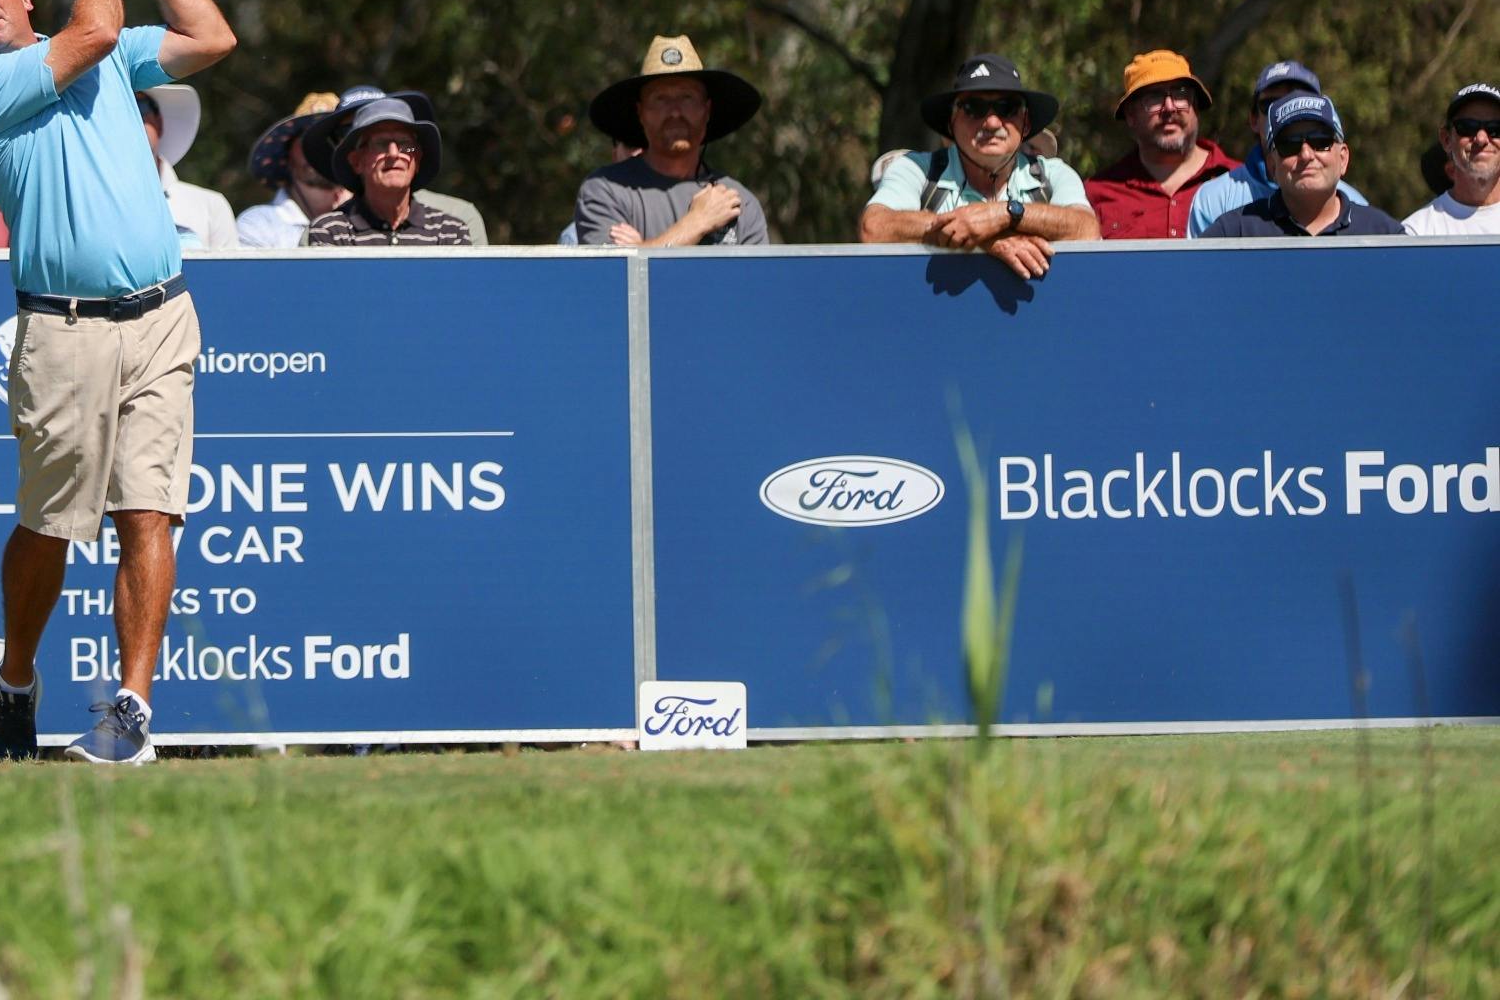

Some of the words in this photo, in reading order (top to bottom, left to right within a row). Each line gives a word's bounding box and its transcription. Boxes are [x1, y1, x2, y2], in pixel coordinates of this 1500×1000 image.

[185, 463, 308, 514] ONE
[327, 460, 506, 513] WINS
[798, 468, 906, 511] Ford
[999, 450, 1328, 520] Blacklocks
[1344, 446, 1500, 516] Ford
[66, 526, 185, 565] NE
[199, 525, 305, 565] CAR
[208, 587, 257, 615] TO
[70, 634, 293, 682] Blklocks
[304, 632, 410, 680] Ford
[644, 696, 742, 737] Ford
